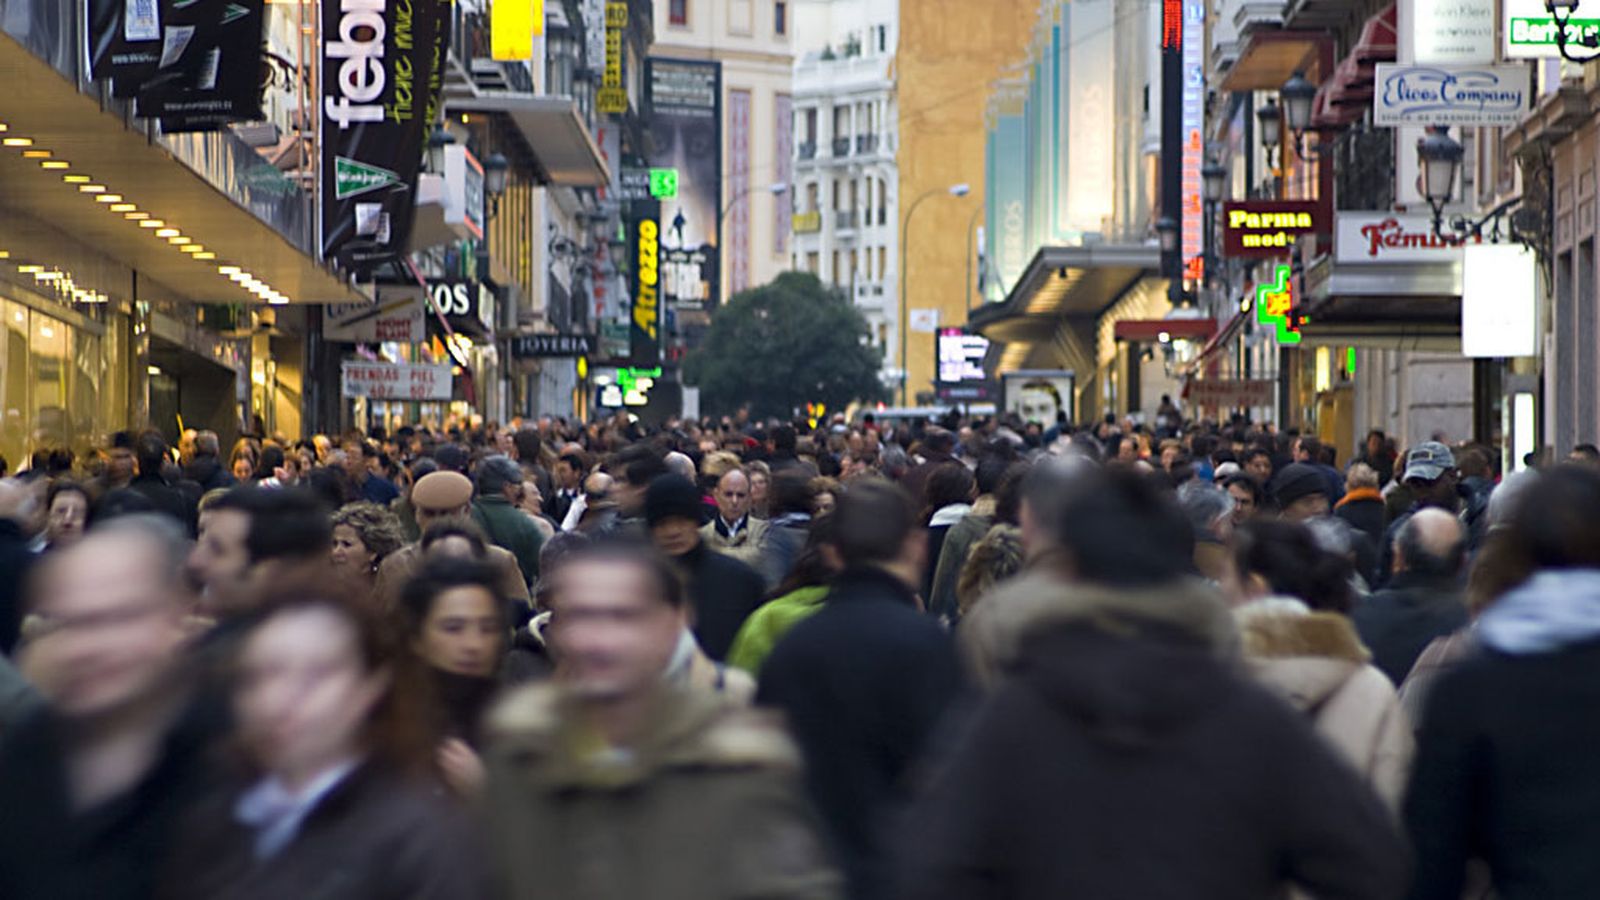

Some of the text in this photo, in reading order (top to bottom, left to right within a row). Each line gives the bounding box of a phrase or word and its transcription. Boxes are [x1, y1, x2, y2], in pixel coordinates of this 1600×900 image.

[384, 55, 413, 125] tiene
[1441, 75, 1521, 111] Company
[1229, 210, 1312, 228] Parma
[634, 219, 658, 340] Atrezzo
[520, 337, 589, 353] JOYERIA
[345, 367, 435, 384] PRENDAS PIEL
